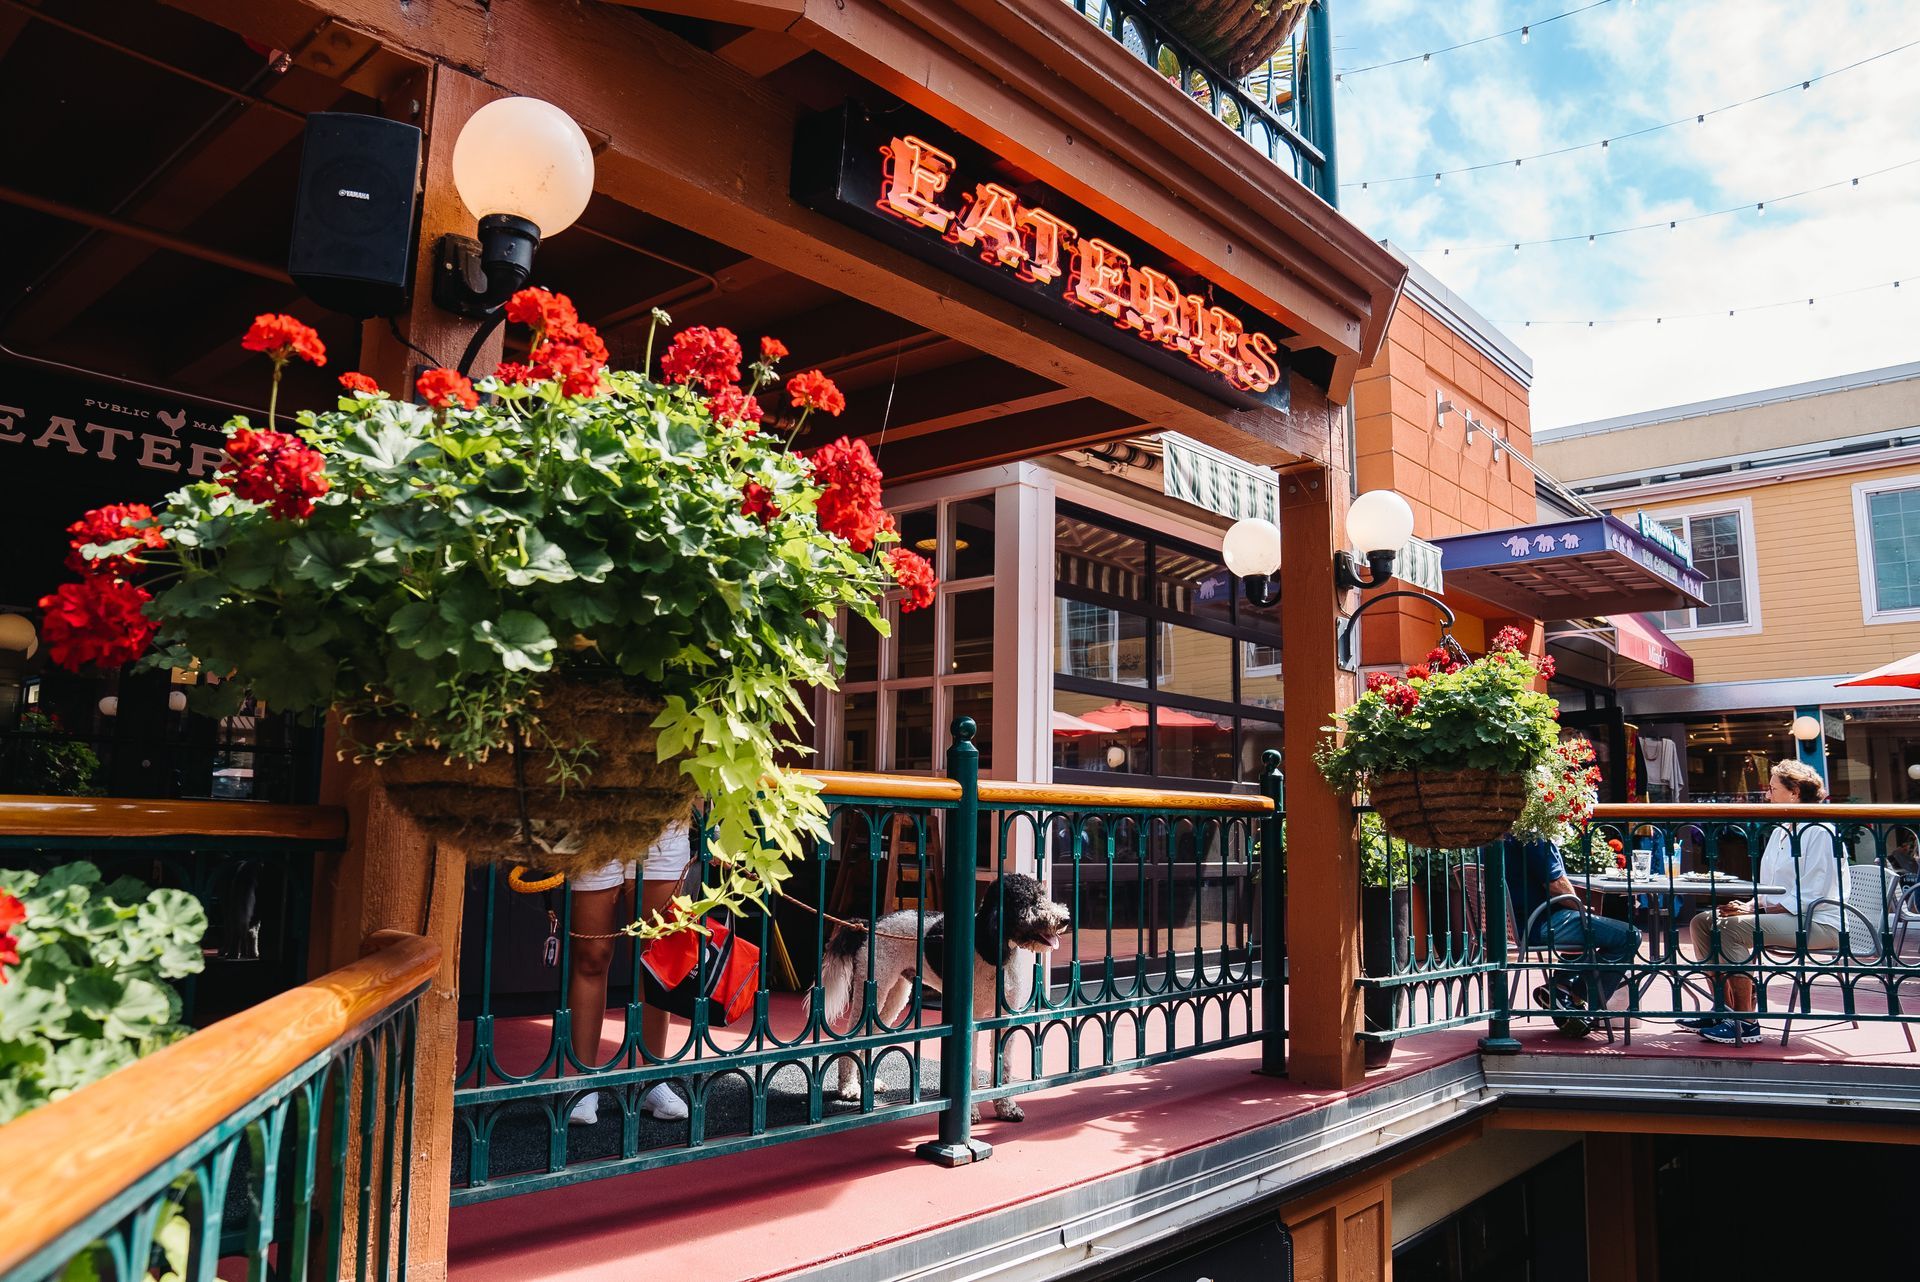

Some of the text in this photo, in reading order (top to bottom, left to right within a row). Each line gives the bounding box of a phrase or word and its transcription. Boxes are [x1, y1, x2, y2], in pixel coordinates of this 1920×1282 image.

[346, 190, 370, 200] YAMAHA
[877, 135, 1281, 393] EATERIES
[85, 399, 150, 418] PUBLIC
